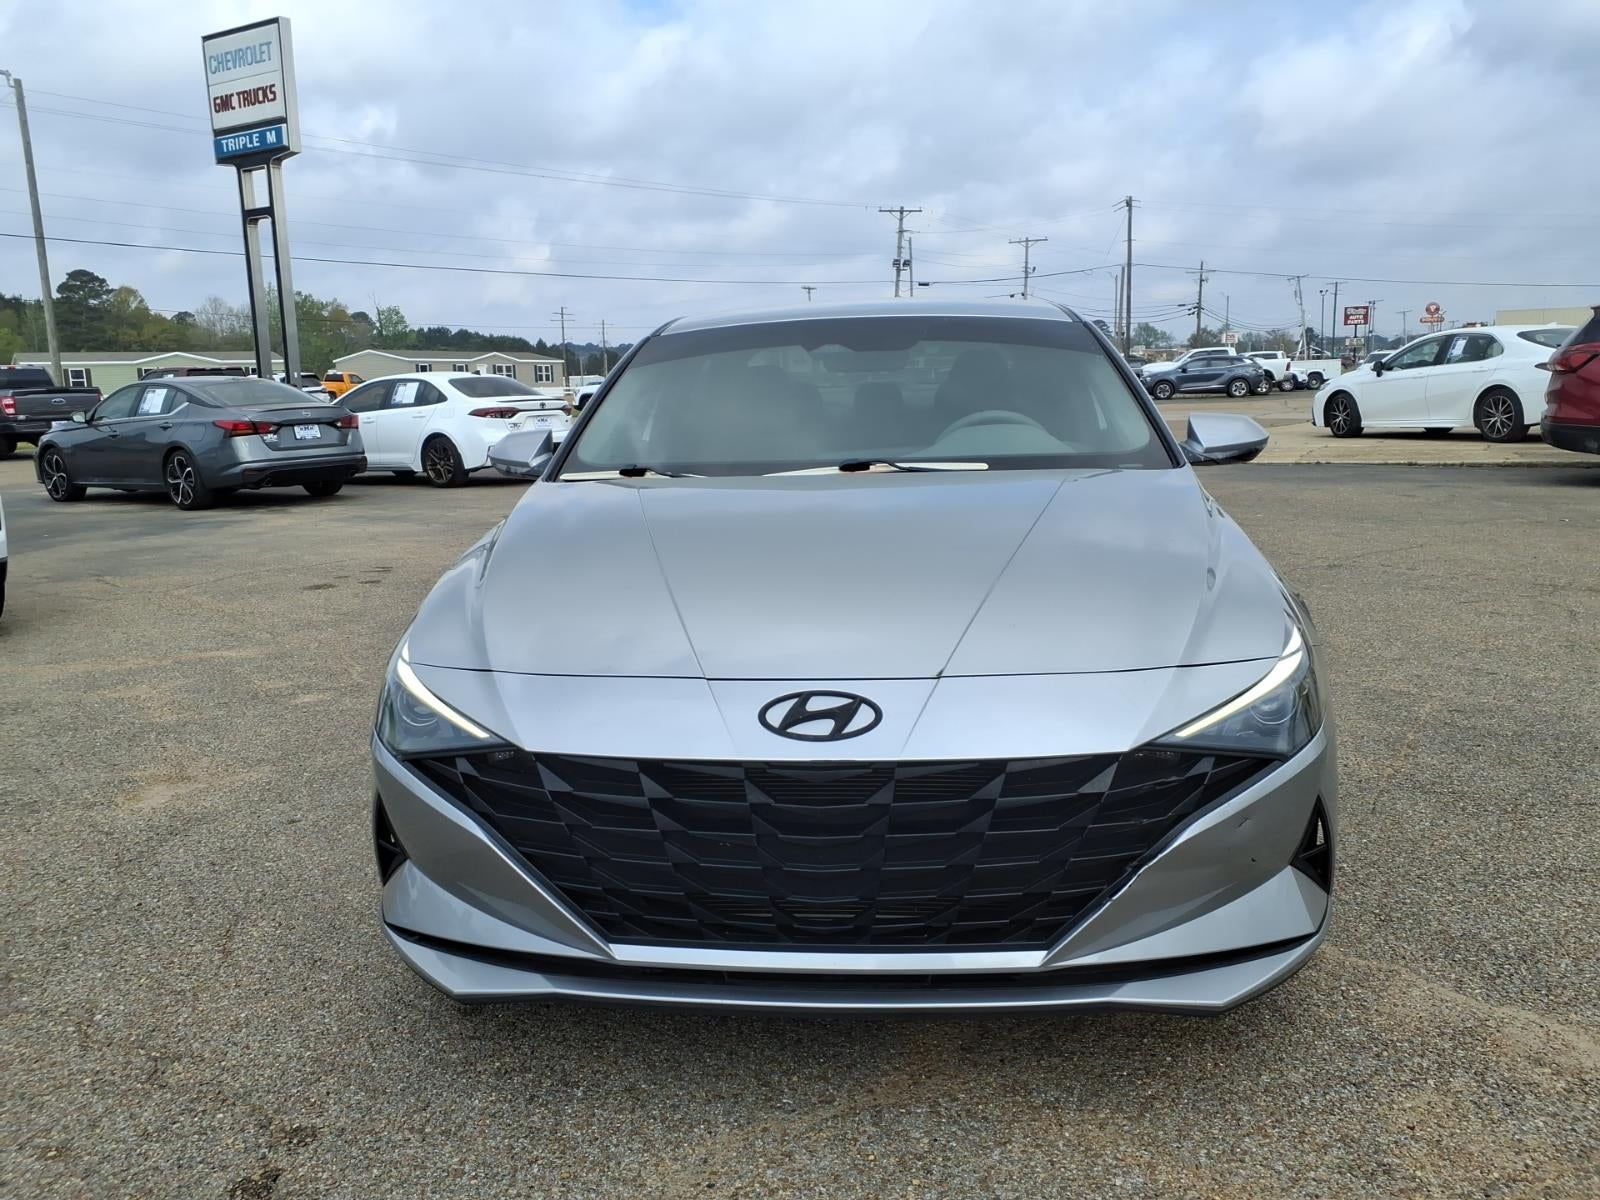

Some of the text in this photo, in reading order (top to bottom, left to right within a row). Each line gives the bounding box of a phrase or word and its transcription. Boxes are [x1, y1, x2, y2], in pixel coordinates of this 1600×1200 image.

[208, 41, 272, 74] CHEVROLET
[213, 84, 277, 113] GMC TRUCKS
[221, 130, 276, 152] TRIPLE M
